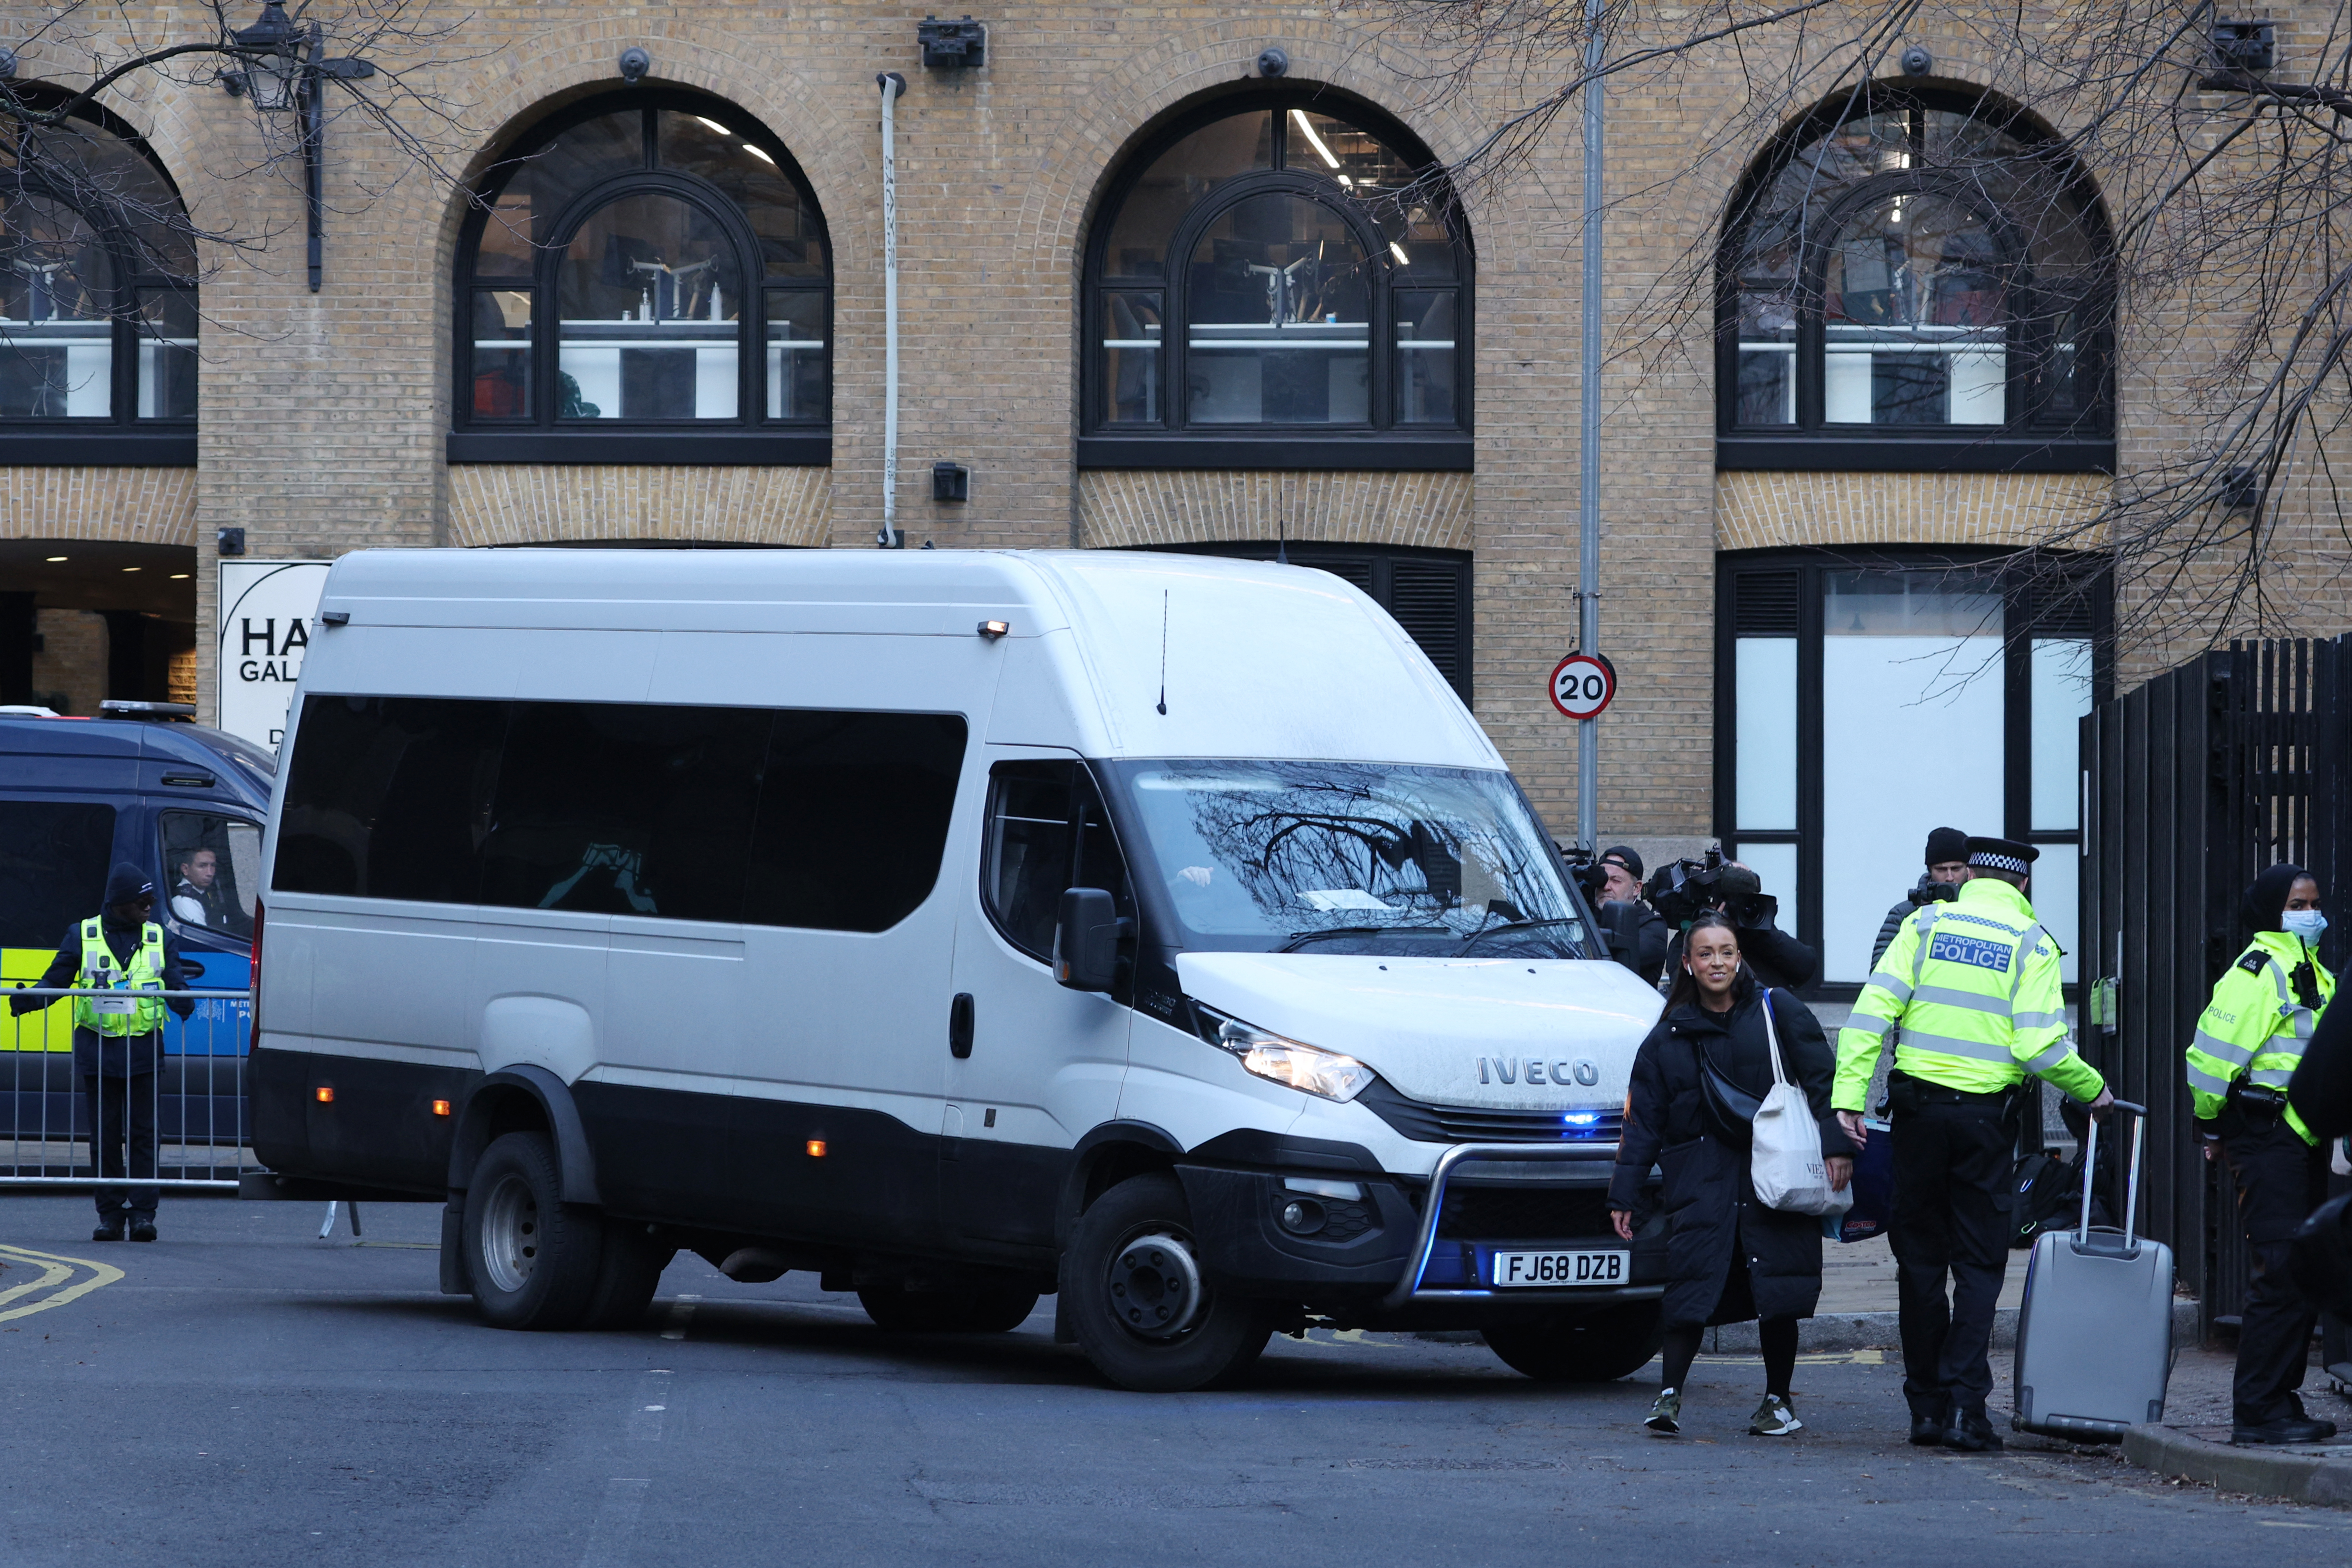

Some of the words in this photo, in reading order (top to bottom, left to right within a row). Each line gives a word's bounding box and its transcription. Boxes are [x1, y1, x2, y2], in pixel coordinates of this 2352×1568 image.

[241, 618, 314, 656] HA
[239, 660, 302, 682] GAL
[1560, 674, 1603, 700] 20
[1931, 942, 2009, 971] POLICE
[1934, 934, 2012, 954] METROPOLITAN
[2208, 1006, 2236, 1024] POLICE
[1476, 1058, 1599, 1086] IVECO
[1509, 1255, 1569, 1281] FJ68
[1576, 1254, 1621, 1280] DZB
